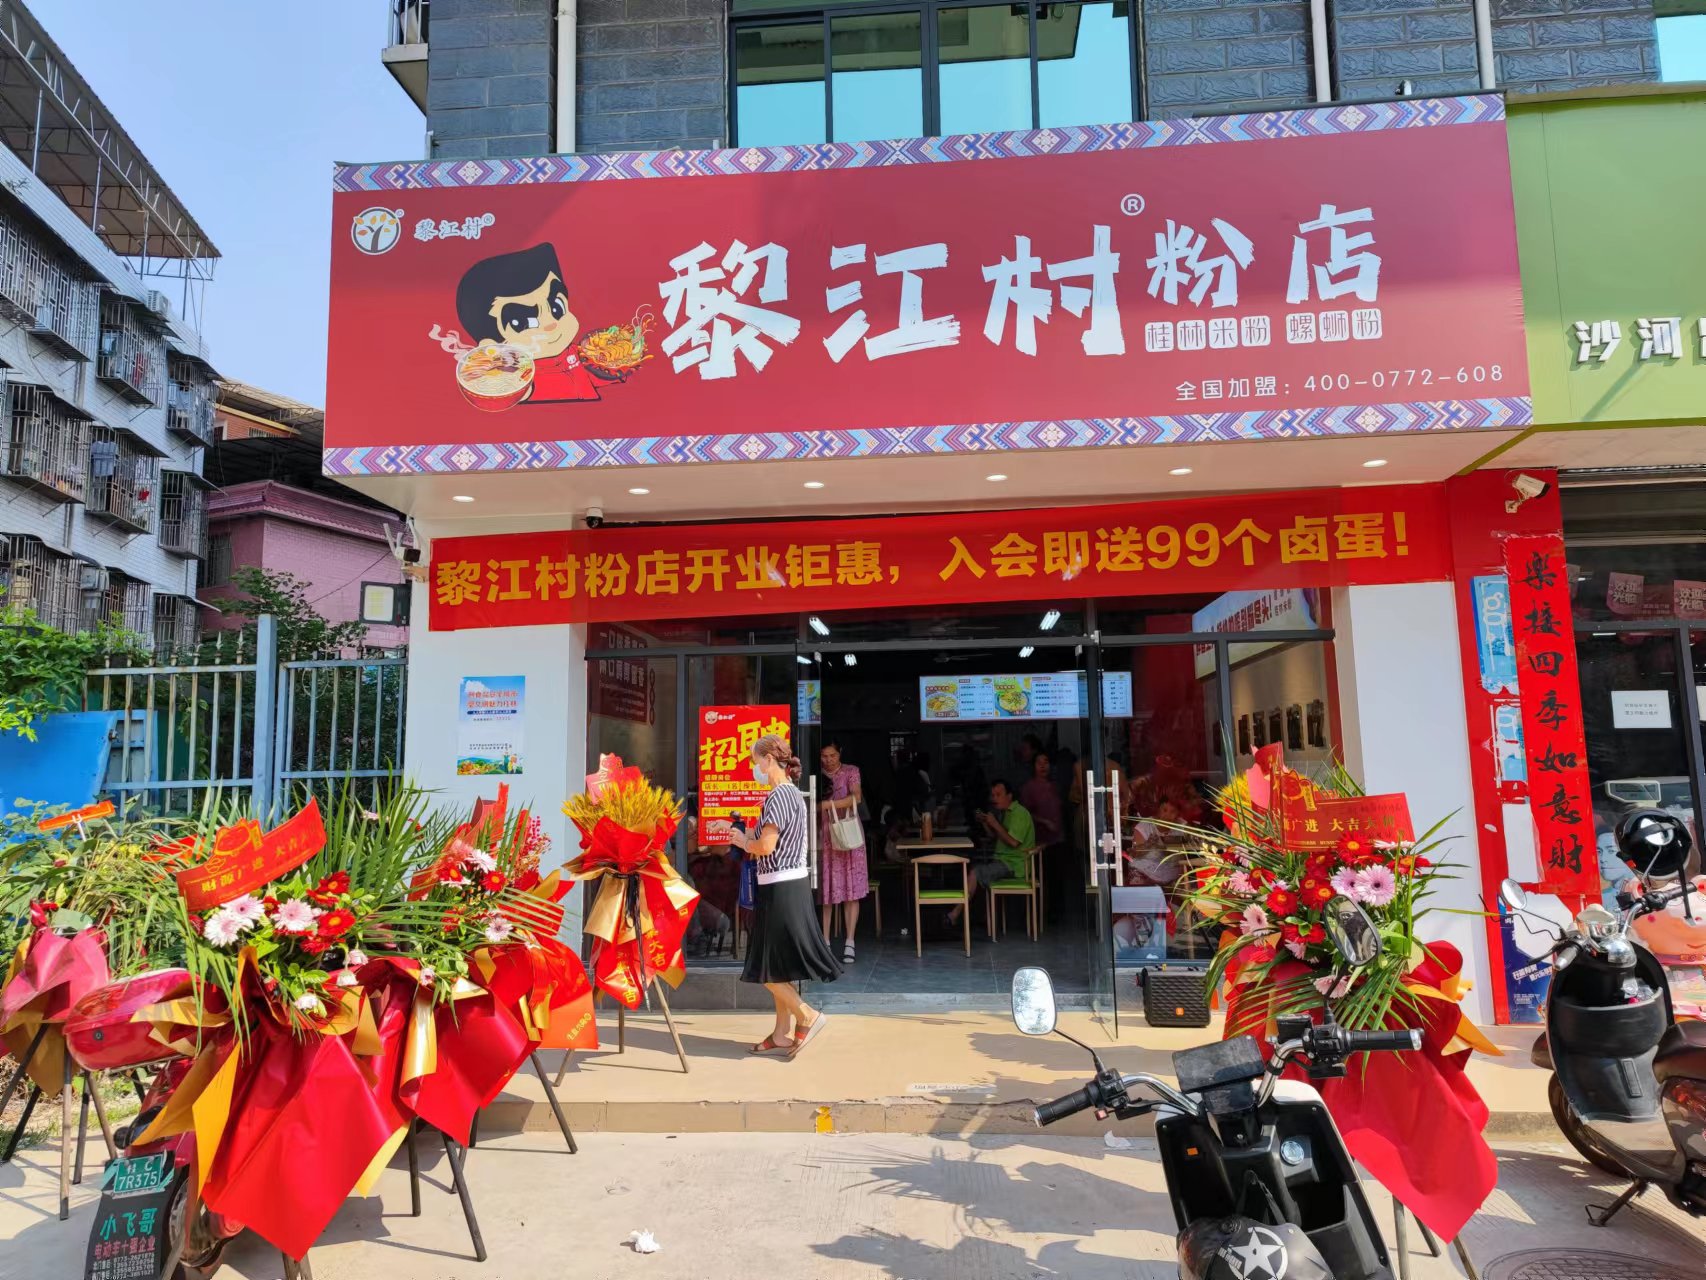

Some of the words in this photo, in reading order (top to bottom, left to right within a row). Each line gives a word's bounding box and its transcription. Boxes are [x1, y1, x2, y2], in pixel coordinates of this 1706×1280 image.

[415, 217, 482, 241] 黎江村
[658, 203, 1381, 380] 黎江村粉店
[1146, 316, 1270, 351] 桂林米粉
[1287, 309, 1382, 343] 螺蛳粉
[1574, 317, 1706, 363] 沙河
[119, 1171, 158, 1191] 7R375
[100, 1208, 157, 1241] 小飞哥
